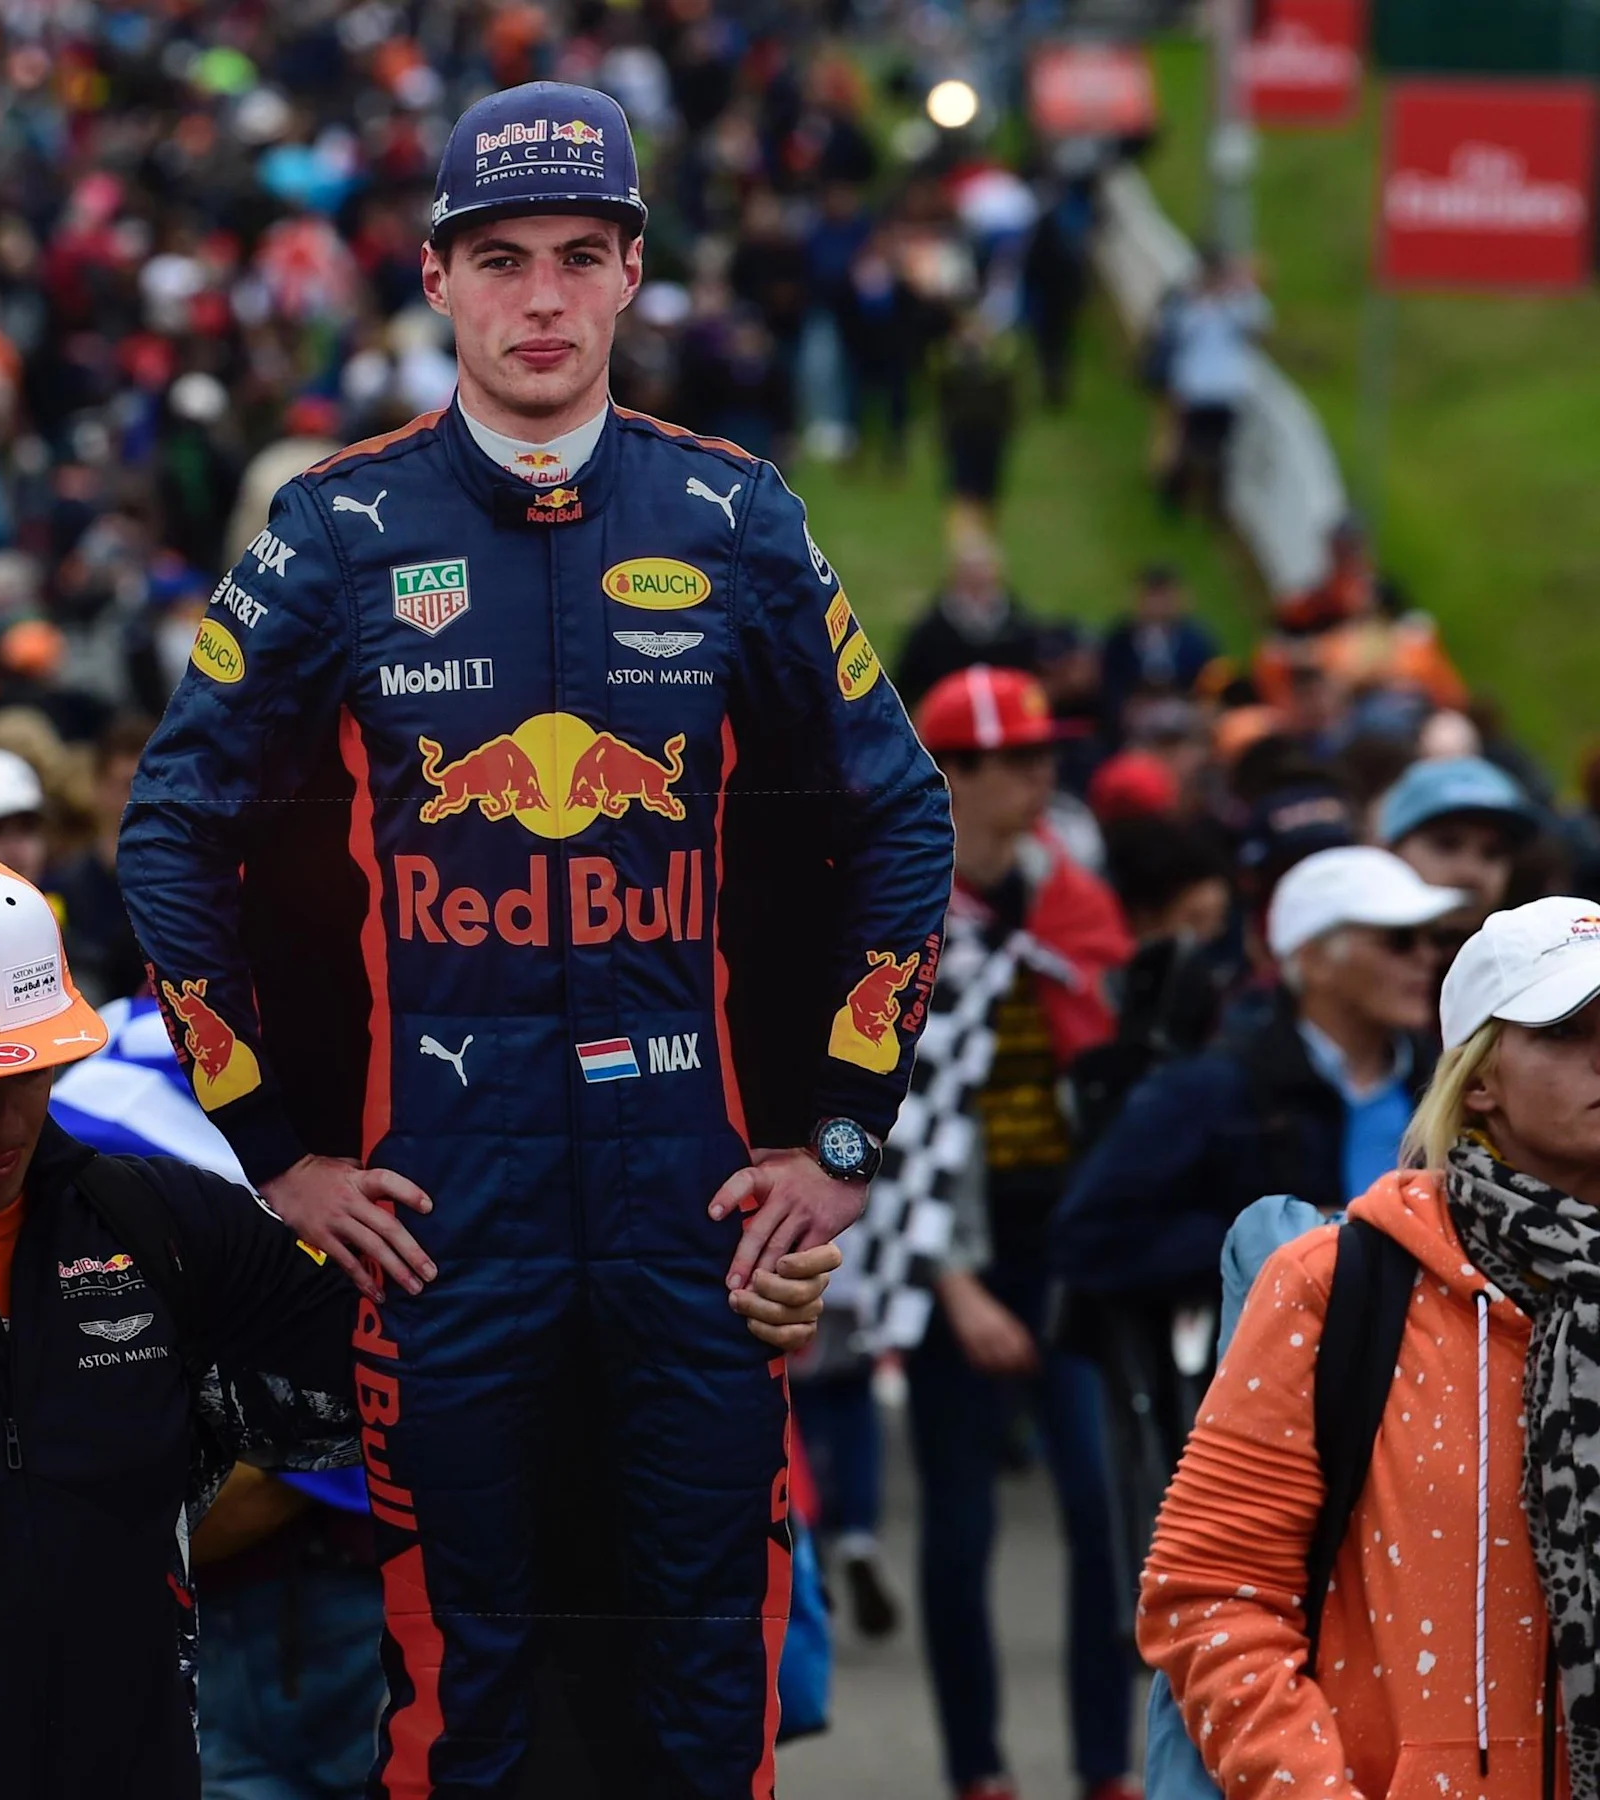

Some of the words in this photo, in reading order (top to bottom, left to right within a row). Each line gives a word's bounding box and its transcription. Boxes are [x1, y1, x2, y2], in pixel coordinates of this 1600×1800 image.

[476, 146, 604, 172] RACING
[476, 167, 534, 187] FORMULA
[541, 167, 567, 176] ONE
[574, 167, 605, 179] TEAM
[527, 507, 556, 523] Red
[556, 501, 583, 522] Bull
[400, 565, 462, 592] TAG
[633, 574, 697, 596] RAUCH
[223, 583, 269, 630] AT&T
[398, 592, 467, 631] HEUER
[198, 632, 239, 676] RAUCH
[379, 659, 461, 696] Mobil
[606, 669, 654, 685] ASTON
[660, 669, 714, 685] MARTIN
[393, 854, 549, 947] Red
[568, 849, 702, 946] Bull
[648, 1033, 701, 1074] MAX
[78, 1352, 121, 1369] ASTON
[124, 1346, 169, 1363] MARTIN
[353, 1361, 418, 1531] Bull
